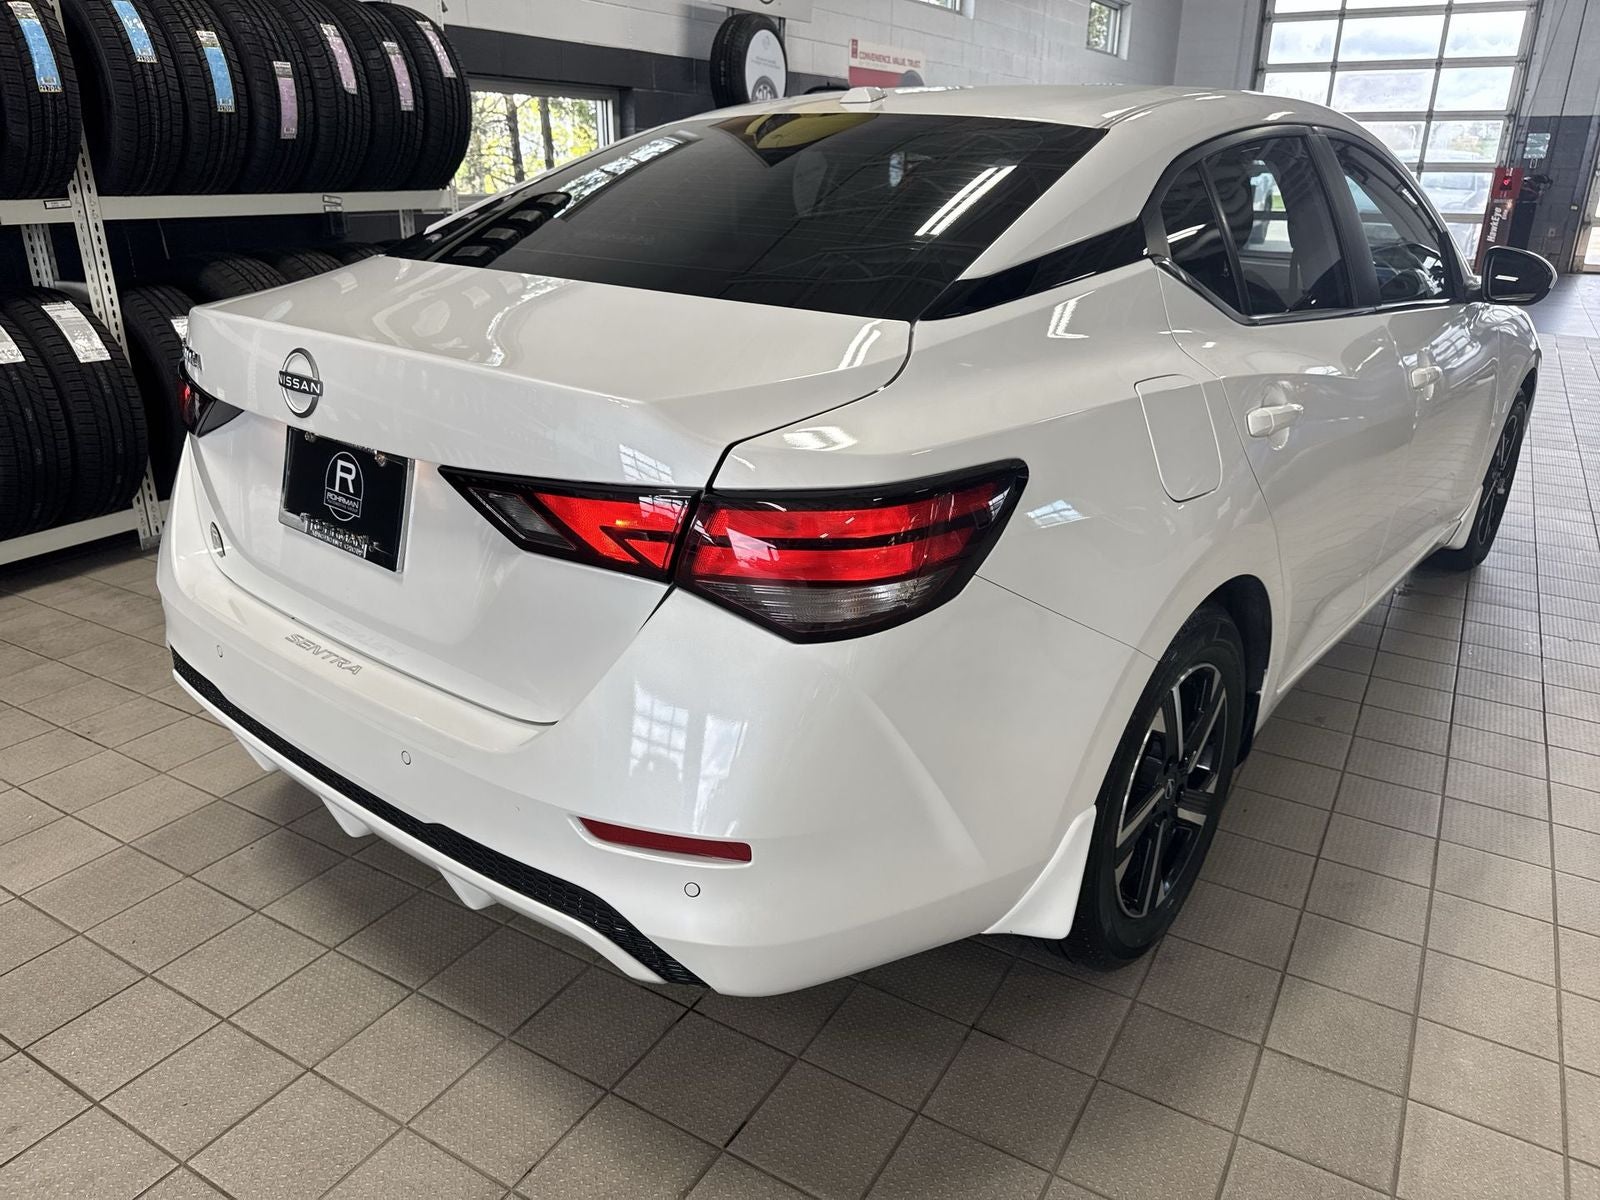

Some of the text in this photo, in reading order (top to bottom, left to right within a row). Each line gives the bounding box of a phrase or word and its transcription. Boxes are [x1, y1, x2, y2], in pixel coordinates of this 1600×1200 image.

[1487, 206, 1503, 243] HawkEye
[279, 373, 320, 394] NISSAN
[335, 459, 357, 494] R
[326, 491, 359, 509] ROHRMAN
[285, 633, 362, 675] SENTRA
